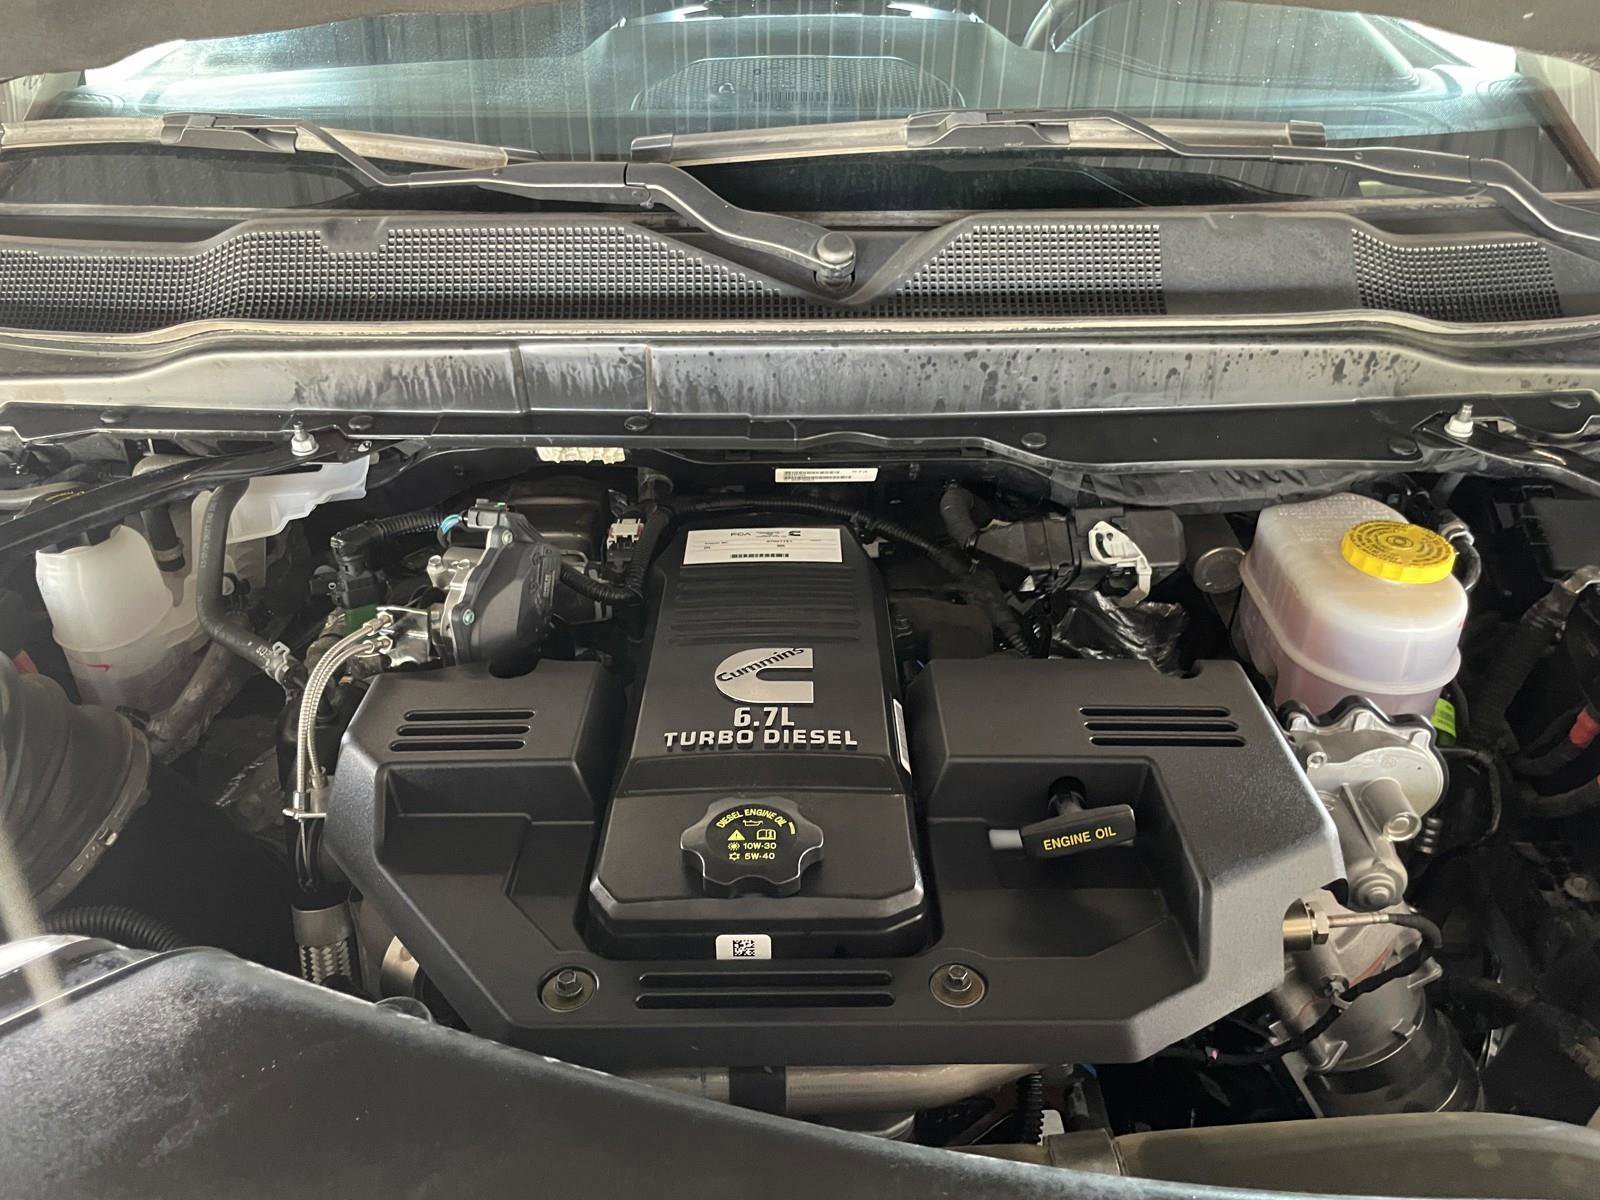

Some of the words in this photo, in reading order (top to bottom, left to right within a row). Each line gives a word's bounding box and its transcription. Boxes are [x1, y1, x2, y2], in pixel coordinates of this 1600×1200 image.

[716, 648, 804, 681] Cummins
[733, 706, 795, 727] 6.7L
[664, 729, 754, 747] TURBO
[763, 729, 858, 746] DIESEL
[716, 811, 743, 828] DIESEL
[745, 809, 776, 820] ENGINE
[774, 816, 787, 828] OIL
[1043, 832, 1091, 850] ENGINE
[1095, 826, 1117, 840] OIL
